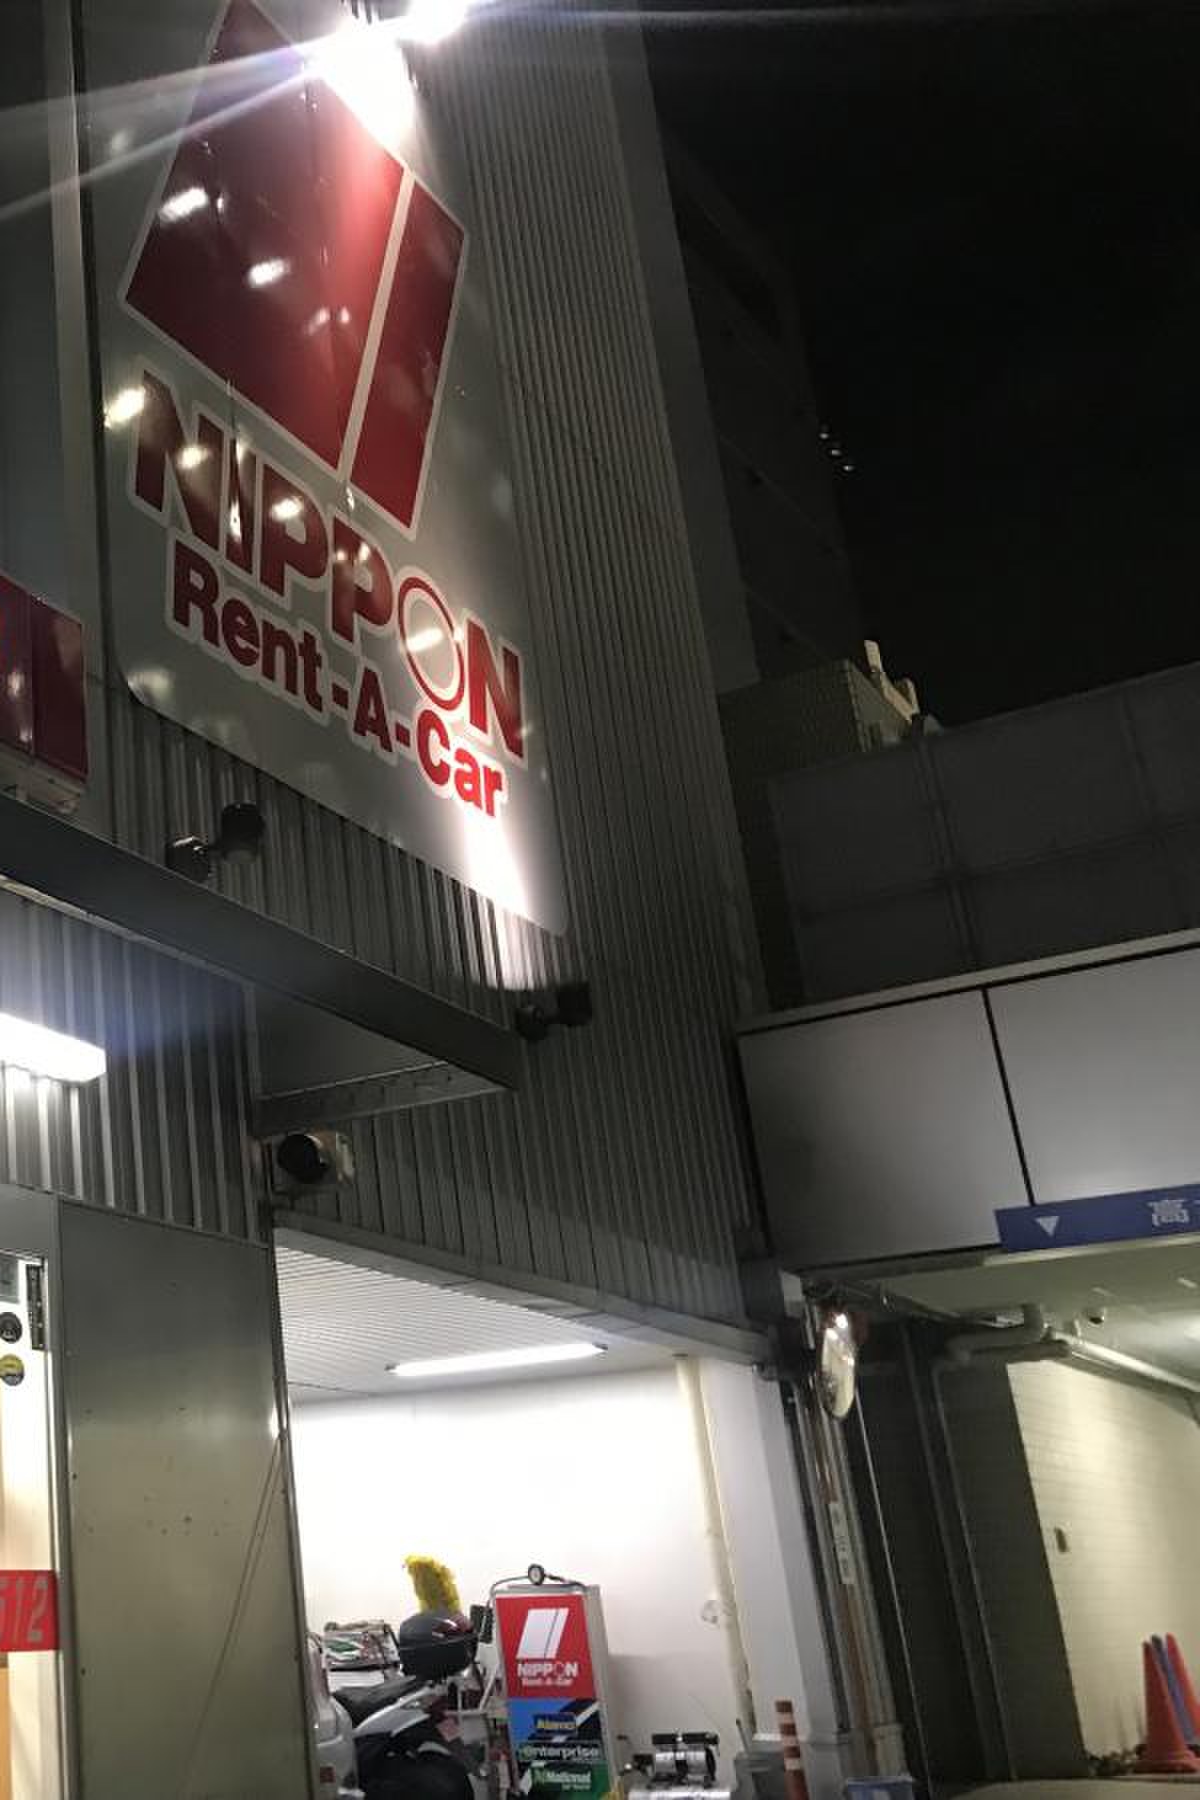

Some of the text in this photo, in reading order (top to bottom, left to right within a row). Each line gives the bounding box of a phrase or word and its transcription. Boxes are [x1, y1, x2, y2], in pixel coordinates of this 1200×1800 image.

[134, 370, 524, 759] NIPPON
[173, 539, 503, 818] Rent-A-Car
[1147, 1199, 1200, 1227] 高
[517, 1660, 579, 1678] NIPPON
